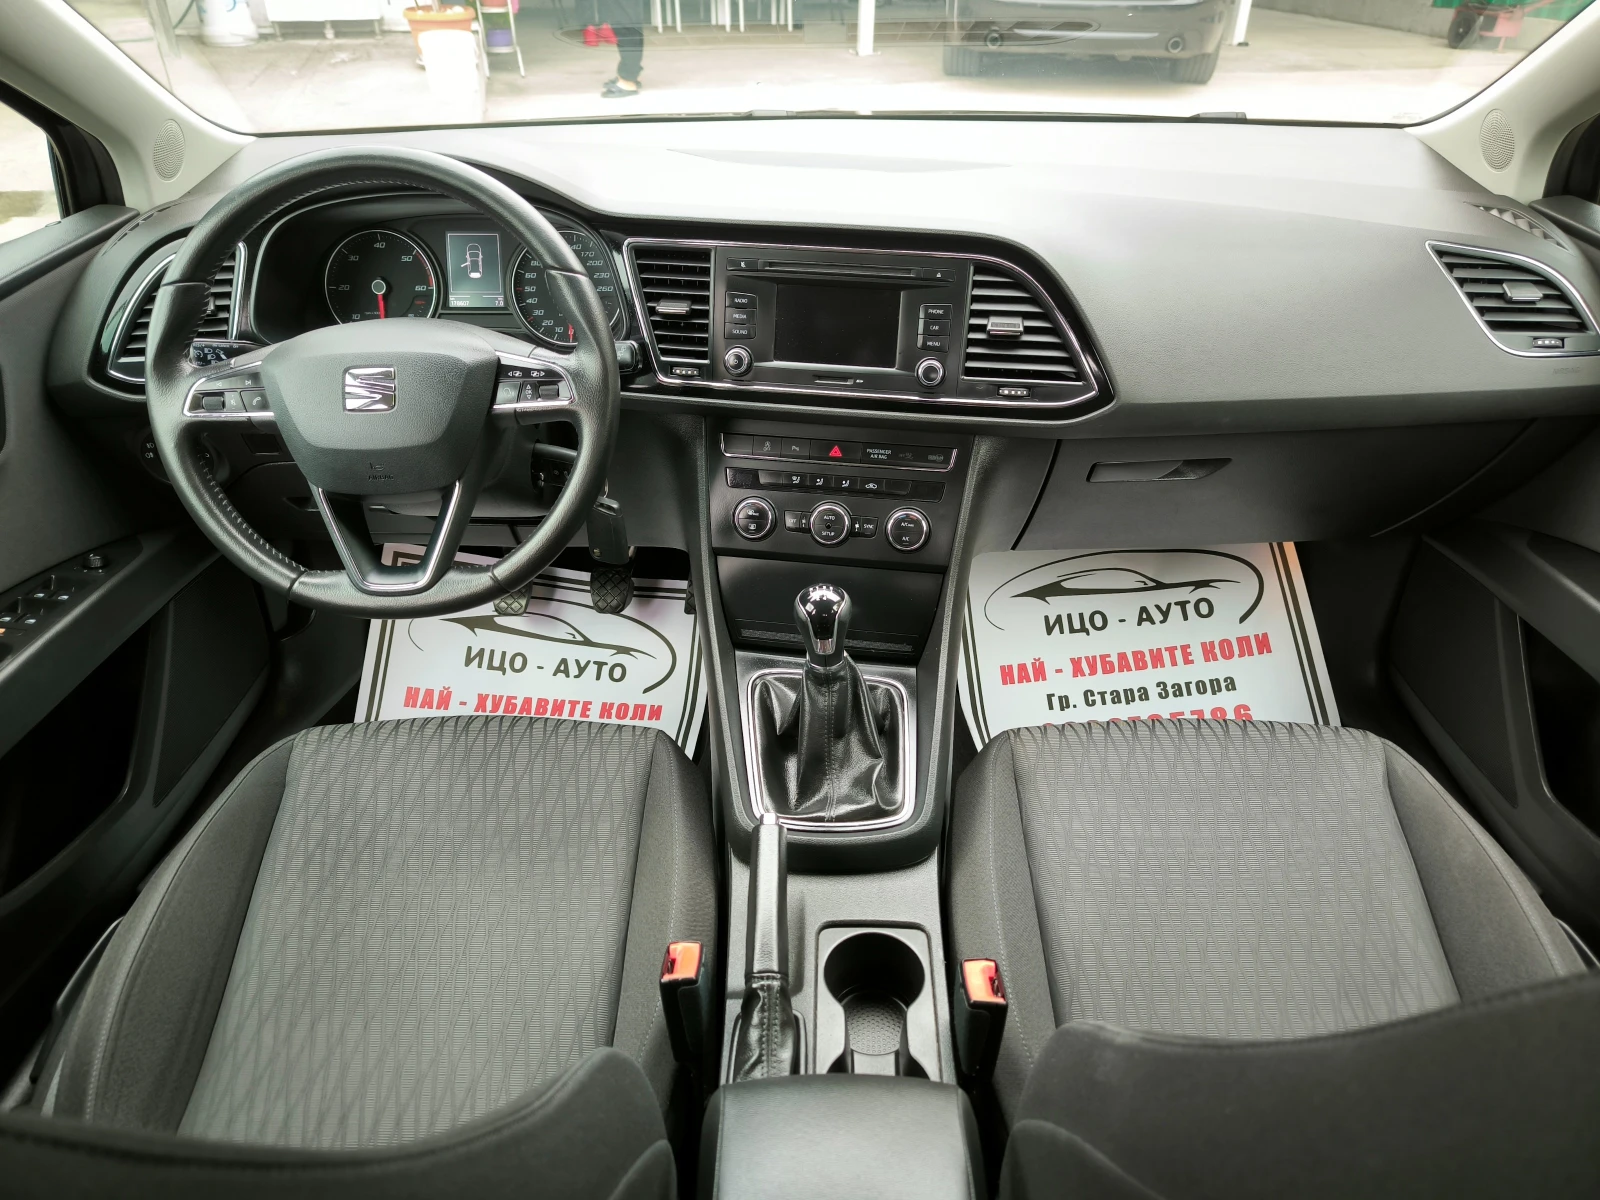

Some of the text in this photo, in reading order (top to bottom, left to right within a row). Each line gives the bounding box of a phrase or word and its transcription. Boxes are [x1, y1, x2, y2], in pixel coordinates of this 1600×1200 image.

[1044, 610, 1109, 636] ИЦО
[1136, 598, 1215, 627] АУТО
[464, 645, 528, 676] ИЦО
[552, 658, 627, 683] АУТО
[1000, 658, 1048, 686] НАЙ
[1070, 644, 1195, 678] ХУБАВИТЕ
[1200, 632, 1273, 663] КОЛИ
[403, 686, 453, 710] НАЙ
[474, 693, 592, 719] ХУБАВИТЕ
[599, 702, 663, 721] КОЛИ
[1046, 676, 1237, 711] Гр. Стара Загора
